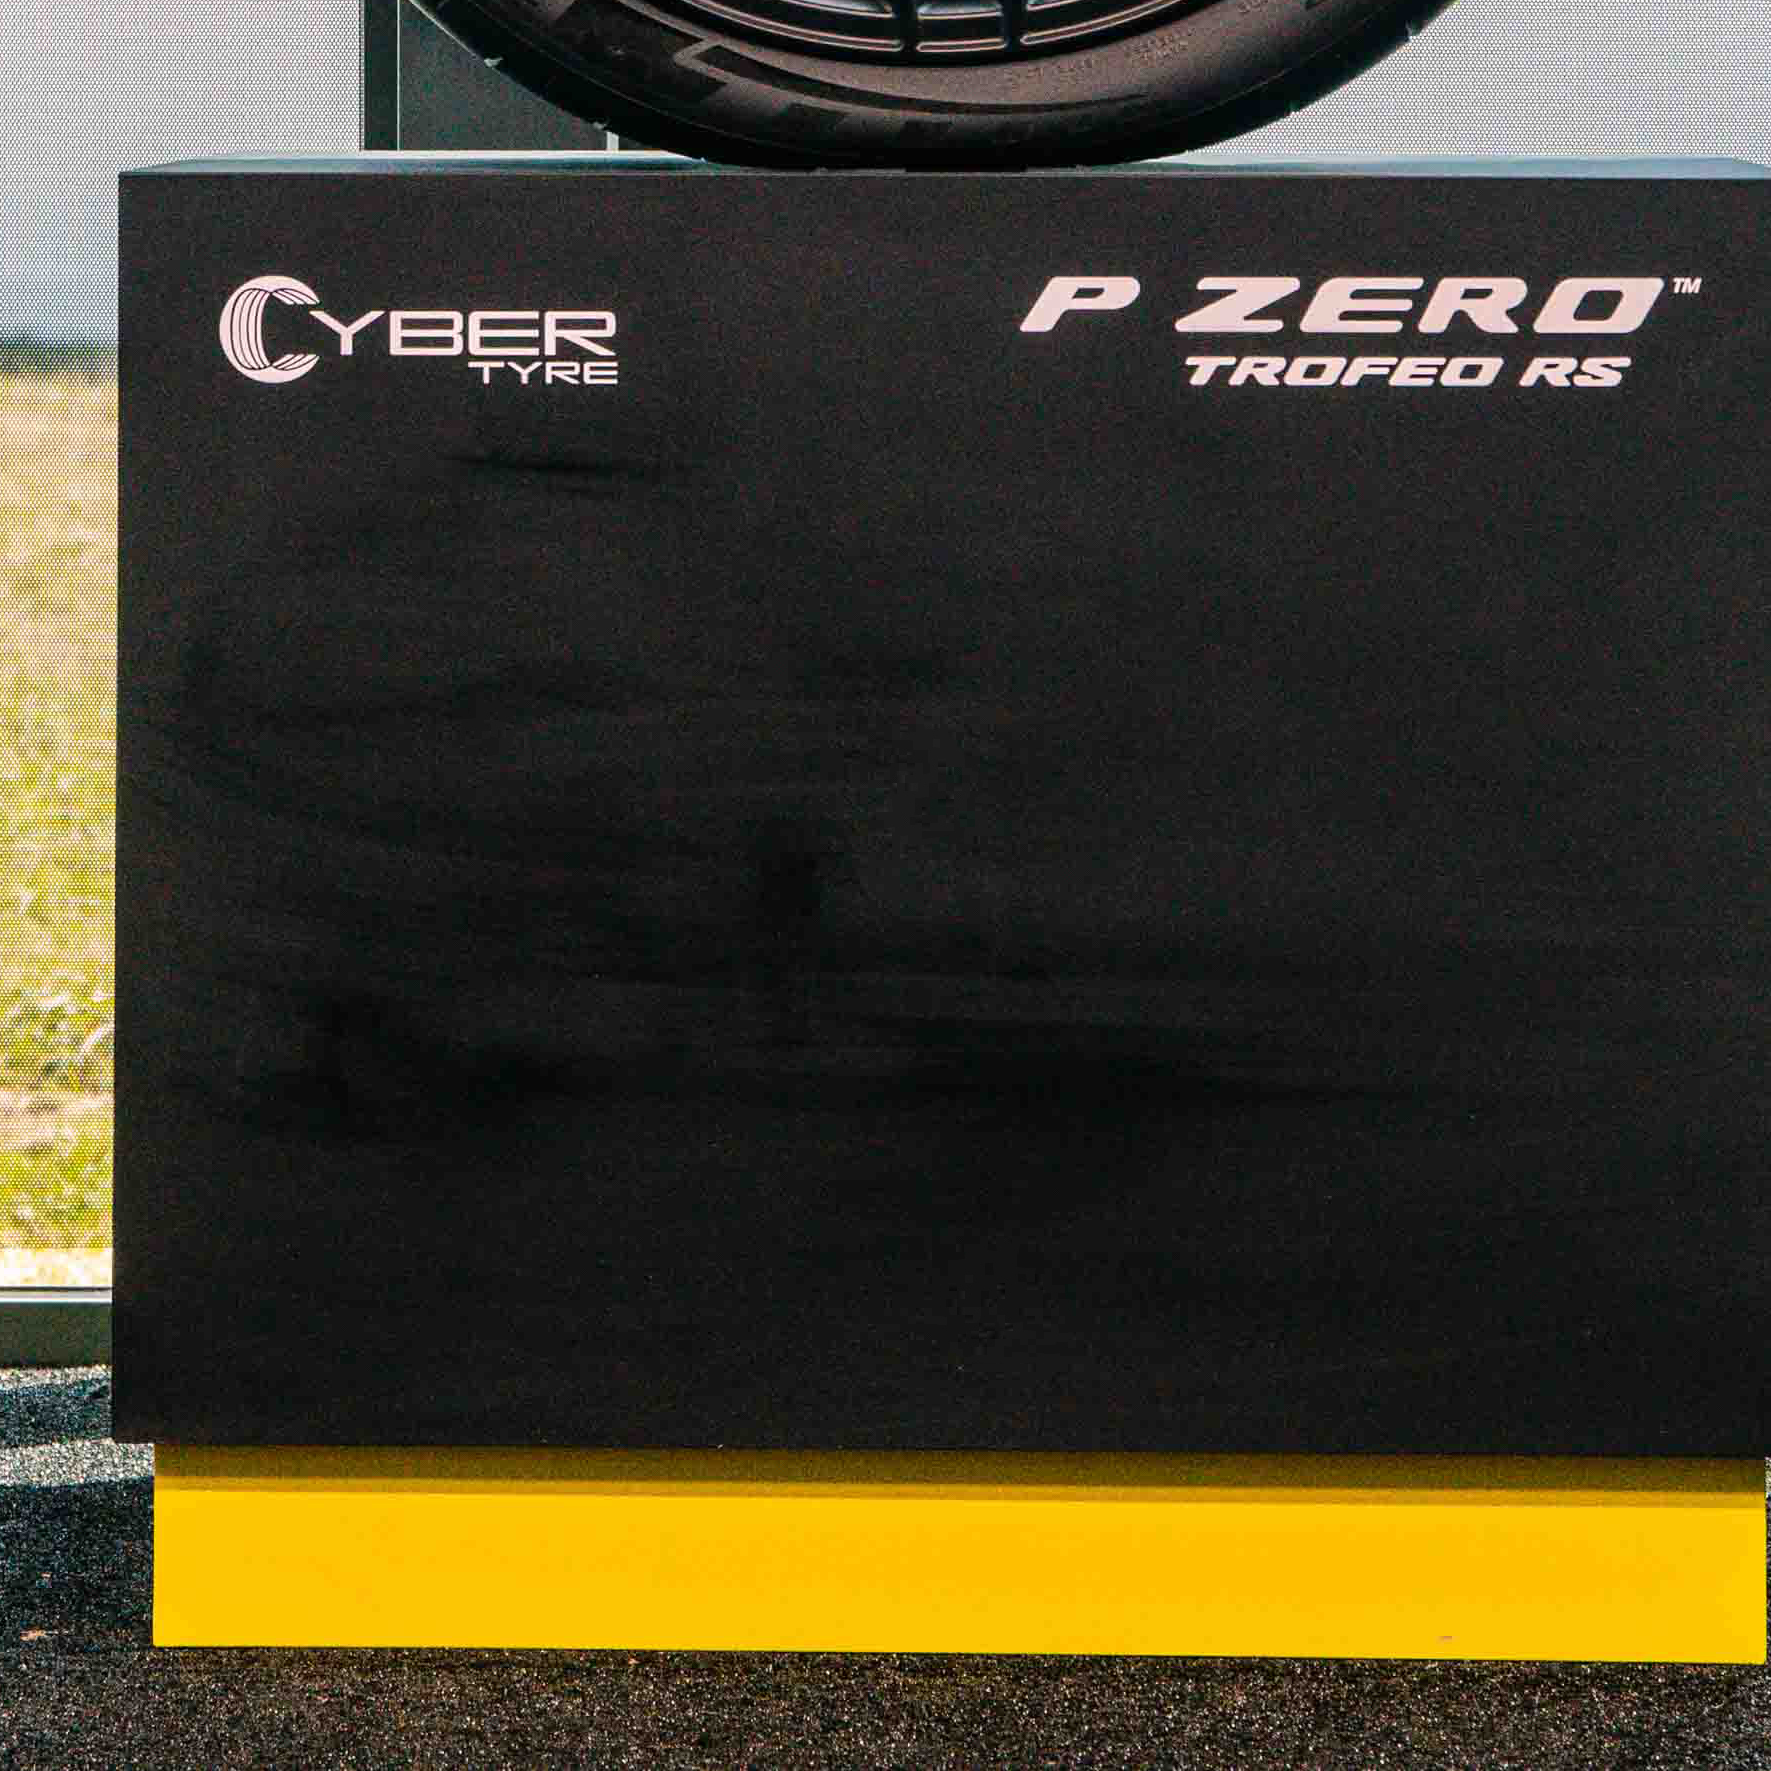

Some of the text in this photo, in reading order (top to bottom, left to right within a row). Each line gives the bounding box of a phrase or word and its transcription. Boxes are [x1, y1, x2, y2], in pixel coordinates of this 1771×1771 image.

[1019, 276, 1141, 333] P
[218, 275, 618, 384] CYBER
[467, 360, 619, 386] TYRE
[1184, 355, 1632, 387] TROFEO RS
